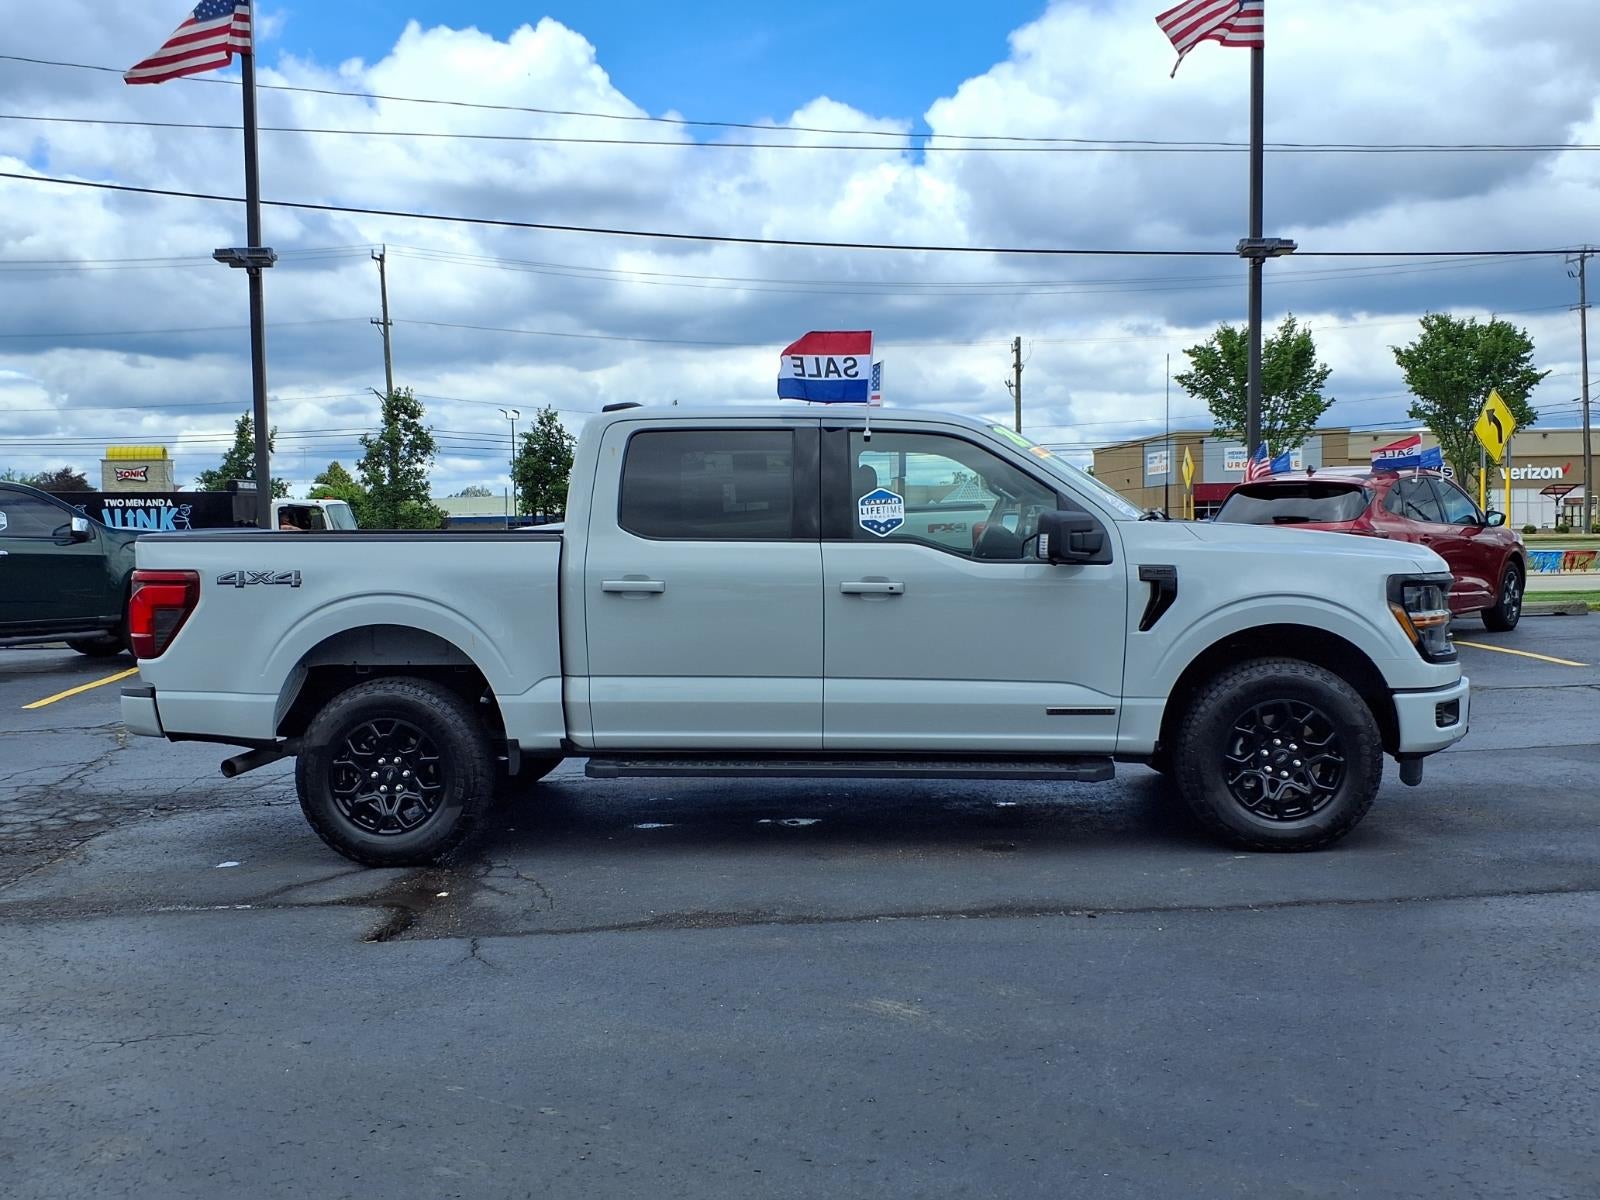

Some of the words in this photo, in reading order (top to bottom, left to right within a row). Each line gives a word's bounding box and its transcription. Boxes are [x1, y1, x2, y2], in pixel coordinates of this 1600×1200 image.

[118, 470, 146, 478] SONIC
[1500, 464, 1563, 479] verizon
[104, 499, 124, 507] TWO
[125, 499, 144, 507] MEN
[145, 499, 165, 507] AND
[166, 499, 173, 507] A
[861, 505, 903, 515] LIFETIME
[217, 570, 302, 588] 4X4
